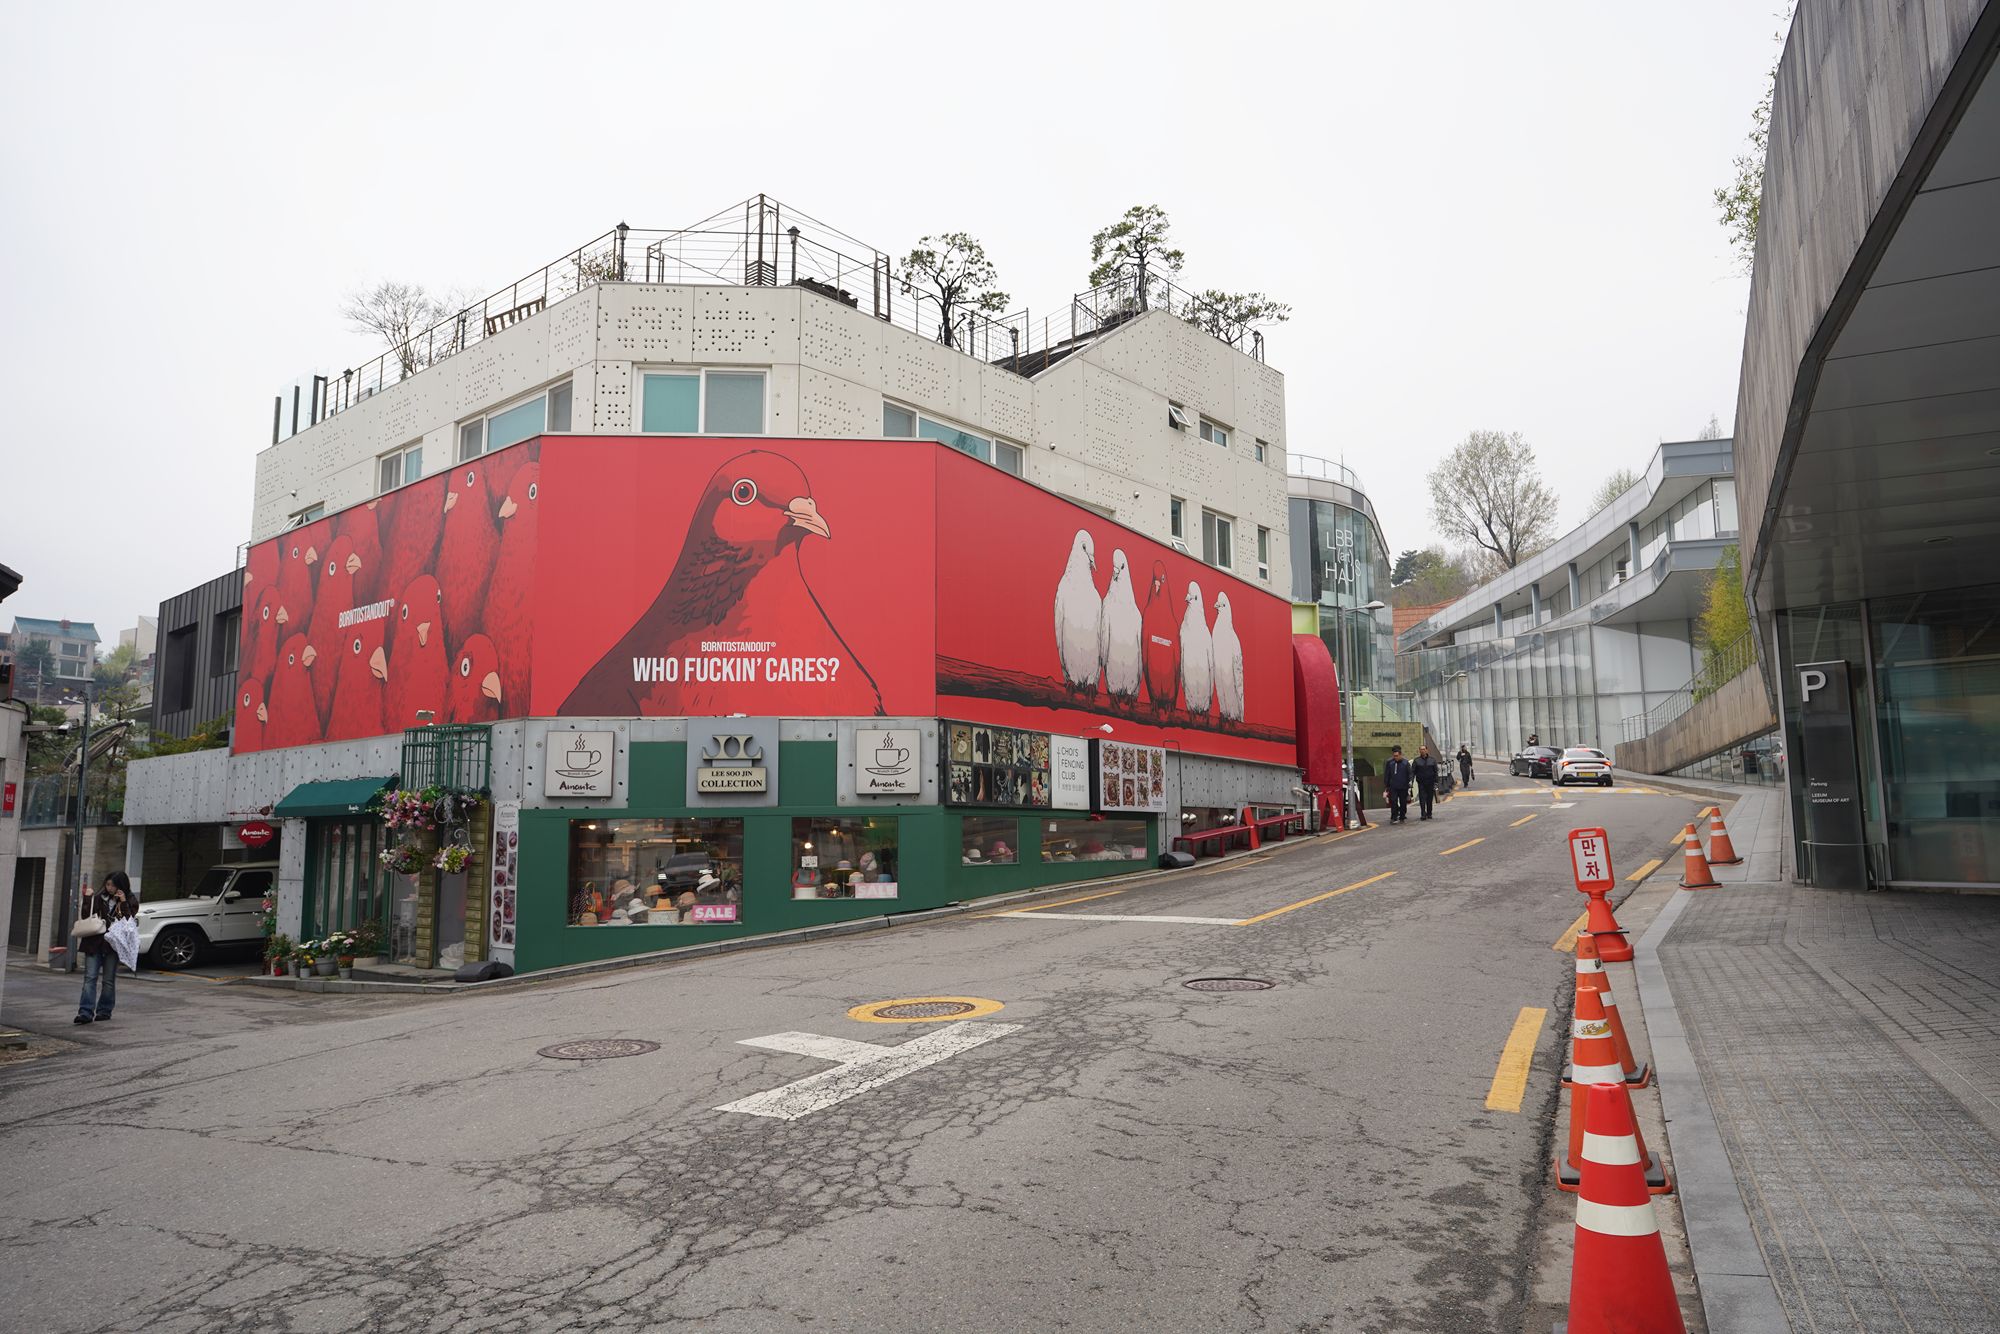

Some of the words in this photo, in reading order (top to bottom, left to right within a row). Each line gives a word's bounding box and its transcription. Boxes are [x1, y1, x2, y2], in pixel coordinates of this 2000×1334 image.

[1326, 529, 1354, 550] LBB
[1325, 559, 1361, 585] HAUS
[632, 657, 679, 682] WHO
[684, 657, 762, 682] FUCKIN’
[765, 657, 840, 682] CARES?
[1800, 670, 1826, 702] P
[1061, 746, 1079, 757] CHOI'S
[1061, 758, 1085, 770] FENCING
[1061, 770, 1076, 781] CLUB
[559, 780, 598, 791] Amante
[701, 779, 763, 788] COLLECTION
[869, 778, 906, 788] Amante
[1581, 838, 1601, 880] 만차
[858, 884, 897, 897] SALE
[694, 907, 733, 919] SALE
